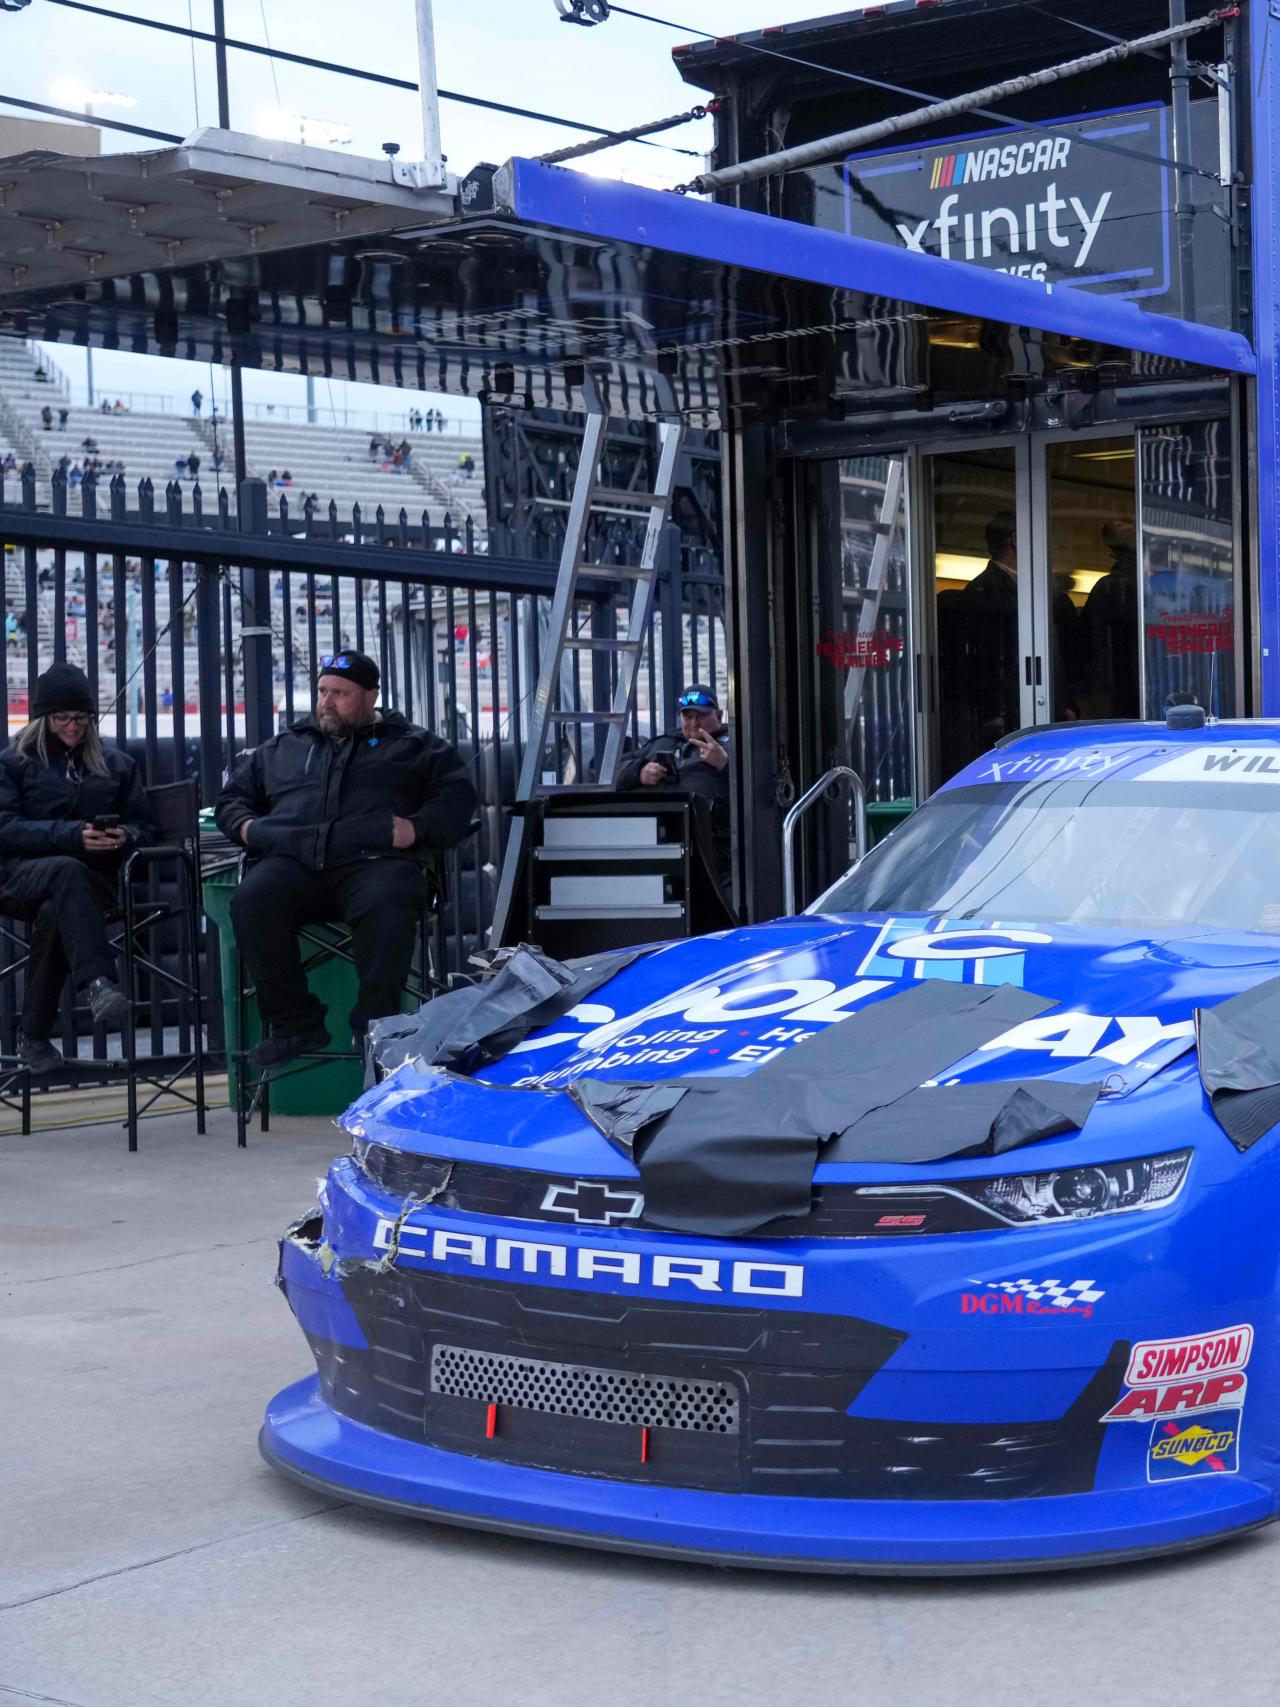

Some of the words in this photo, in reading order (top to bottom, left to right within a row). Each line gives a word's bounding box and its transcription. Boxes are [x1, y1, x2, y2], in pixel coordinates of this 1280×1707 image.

[963, 137, 1071, 184] NASCAR
[896, 182, 1112, 268] xfinity
[979, 751, 1130, 782] xfinity
[372, 1218, 805, 1298] CAMARO
[960, 1294, 1024, 1315] DGM
[1137, 1334, 1243, 1379] SIMPSON
[1107, 1373, 1246, 1416] ARP
[1155, 1433, 1233, 1457] SUNOCO
